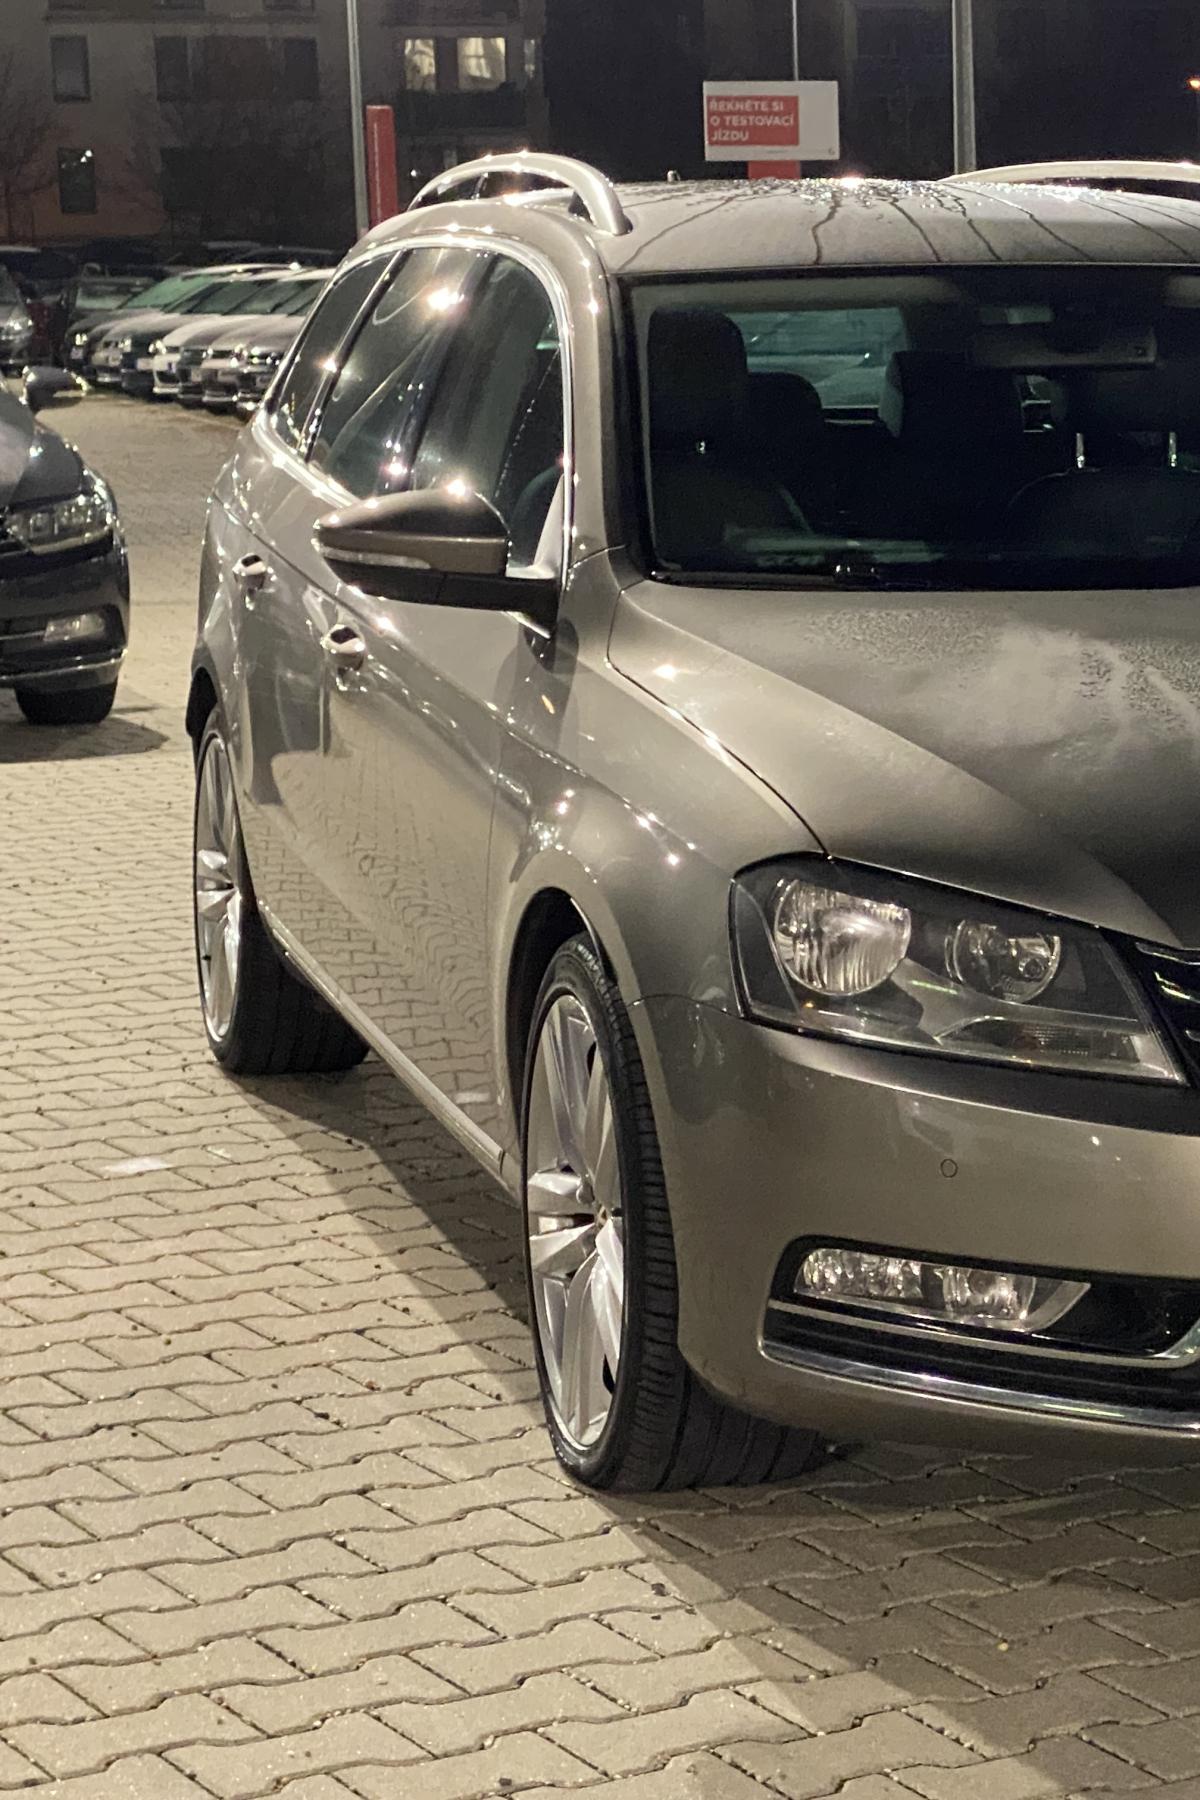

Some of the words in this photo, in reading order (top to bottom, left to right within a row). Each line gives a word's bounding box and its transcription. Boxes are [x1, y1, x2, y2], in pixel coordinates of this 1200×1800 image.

[771, 100, 784, 112] SI
[709, 115, 720, 126] O
[723, 113, 795, 127] TESTOVACÍ
[711, 128, 750, 142] JÍZDU
